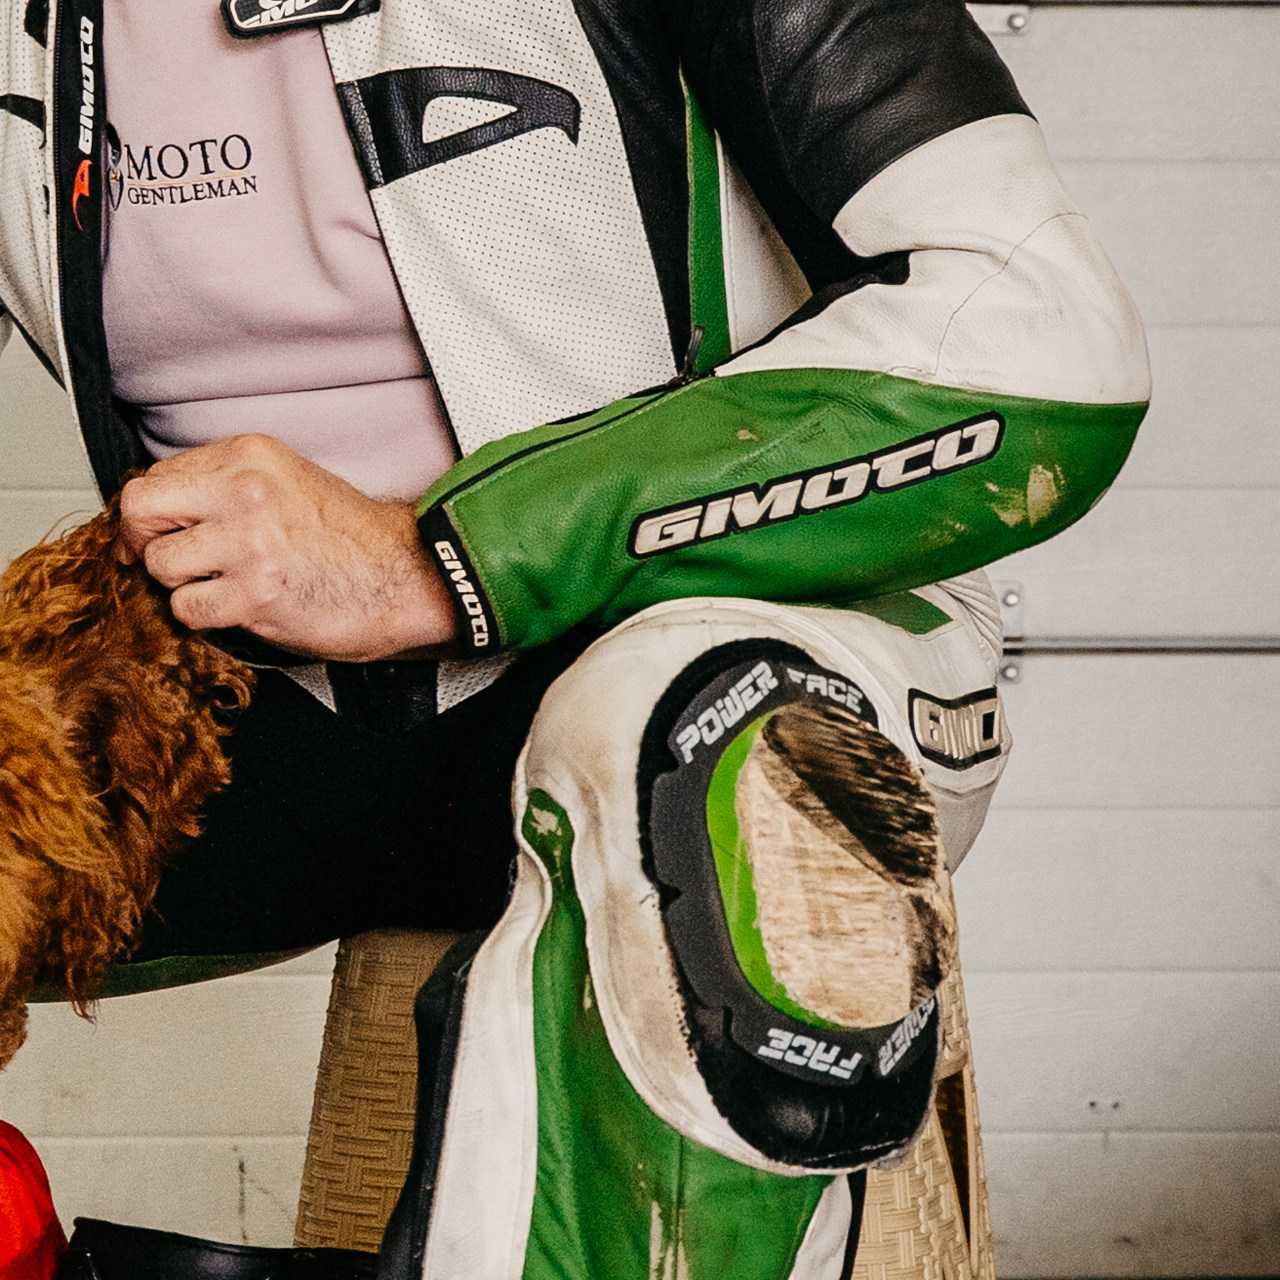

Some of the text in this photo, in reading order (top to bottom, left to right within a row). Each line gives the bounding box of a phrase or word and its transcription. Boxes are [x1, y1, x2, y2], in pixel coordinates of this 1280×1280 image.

[78, 15, 95, 156] GIMOTO
[123, 133, 252, 181] MOTO
[127, 175, 258, 206] GENTLEMAN
[634, 417, 1001, 555] GIMOTO
[434, 540, 489, 647] GIMOTO
[676, 660, 863, 765] POWER FACE
[757, 1027, 863, 1080] FACE
